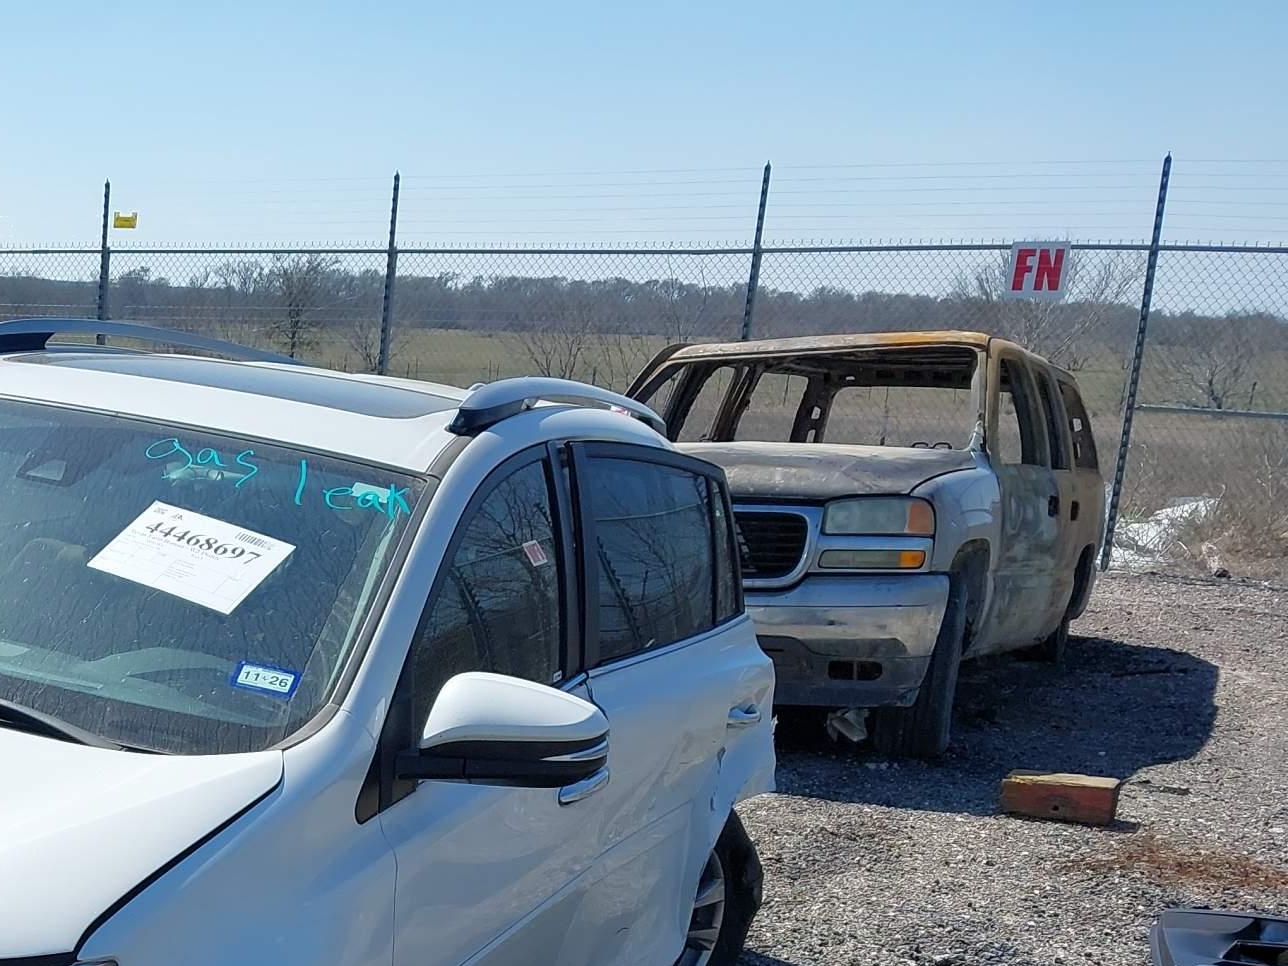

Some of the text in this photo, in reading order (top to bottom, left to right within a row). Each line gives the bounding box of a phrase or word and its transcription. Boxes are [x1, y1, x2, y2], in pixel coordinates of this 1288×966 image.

[1011, 248, 1066, 291] FN
[145, 438, 258, 488] gas
[144, 521, 263, 565] 44468697
